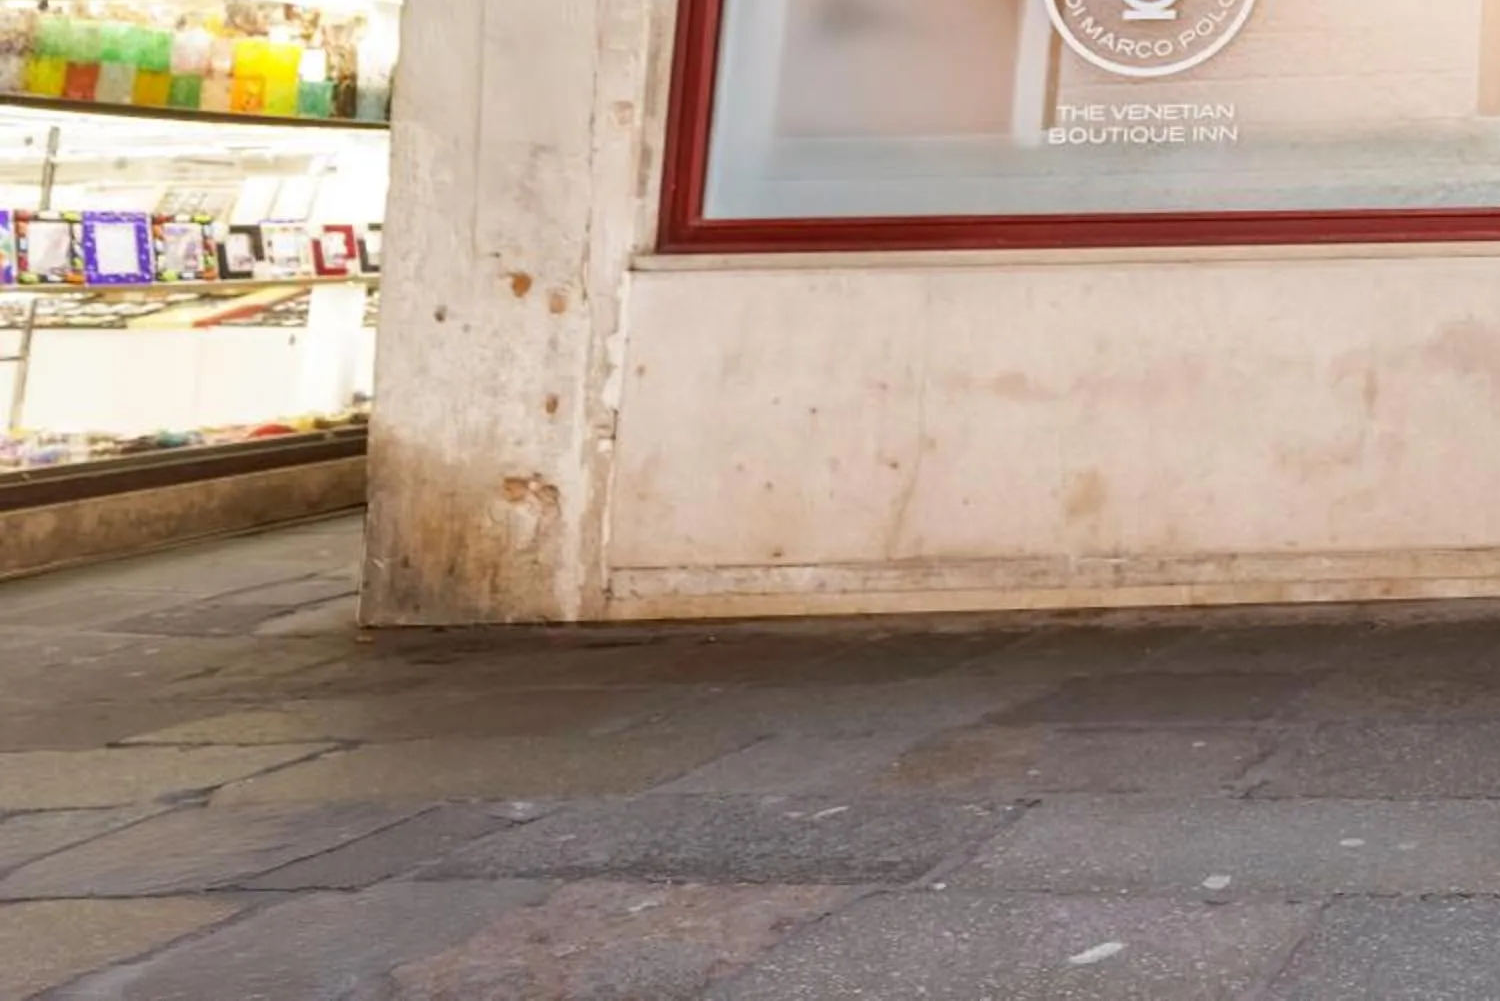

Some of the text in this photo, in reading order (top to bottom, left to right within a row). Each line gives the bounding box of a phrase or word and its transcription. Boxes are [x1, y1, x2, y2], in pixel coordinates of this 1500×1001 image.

[1081, 19, 1174, 58] MARCO
[1056, 102, 1235, 121] THE VENETIAN
[1048, 125, 1238, 145] BOUTIQUE INN
